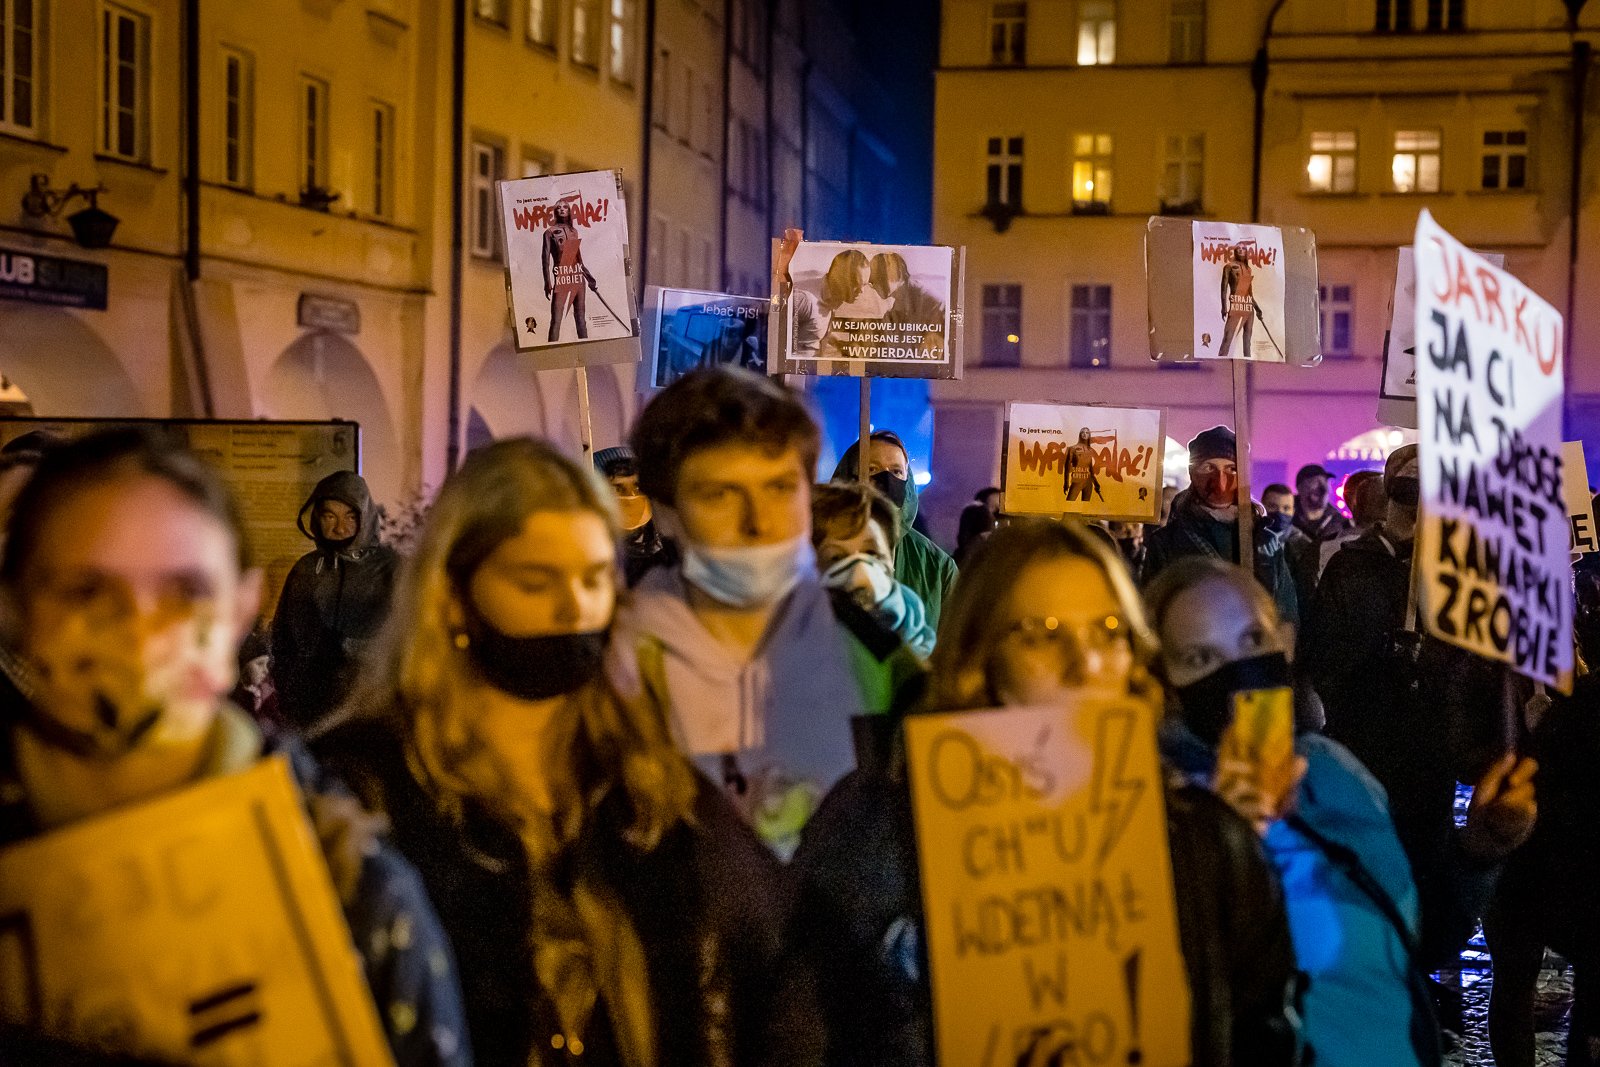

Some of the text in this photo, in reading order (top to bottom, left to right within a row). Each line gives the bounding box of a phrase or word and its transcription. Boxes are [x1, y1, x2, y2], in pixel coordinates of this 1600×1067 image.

[553, 262, 583, 276] STRAJK
[555, 273, 584, 286] KOBIET
[736, 306, 759, 320] PiS!
[1430, 236, 1558, 377] JARKU
[832, 321, 942, 332] W SEJMOWEJ UBIKACJI
[849, 334, 925, 344] NAPISANE JEST:
[842, 346, 944, 359] "WYPIERDALAĆ"
[1428, 308, 1516, 409] JA CI
[1433, 386, 1482, 453] NA
[1439, 454, 1547, 555] NAWET
[1439, 513, 1562, 631] KANAPKI
